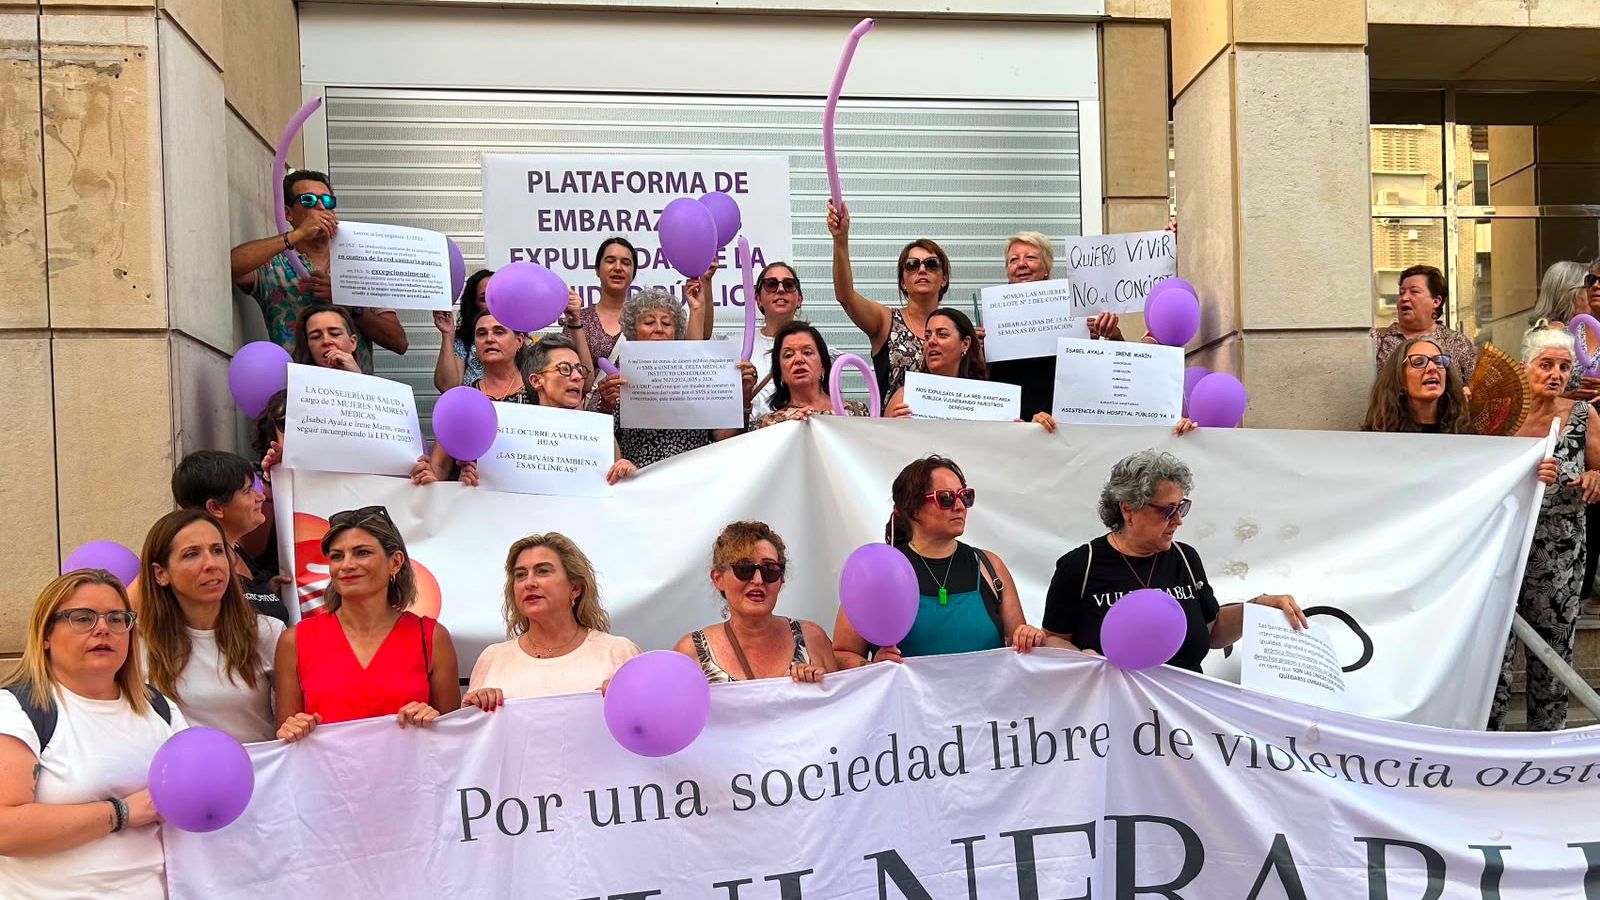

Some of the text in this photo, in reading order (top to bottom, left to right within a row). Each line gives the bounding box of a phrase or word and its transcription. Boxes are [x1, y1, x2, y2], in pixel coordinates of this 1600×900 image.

[527, 171, 749, 194] PLATAFORMA DE
[1038, 288, 1066, 296] MUJERES
[1073, 282, 1098, 307] NO
[1032, 297, 1045, 305] DEL
[997, 319, 1045, 329] EMBARAZADAS
[997, 327, 1027, 336] SEMANAS
[305, 386, 316, 395] LA
[366, 394, 376, 403] DE
[377, 396, 401, 407] SALUD
[300, 396, 319, 406] cargo
[320, 398, 329, 406] de
[375, 404, 403, 416] MADRES
[948, 404, 974, 412] DERECHOS
[1061, 407, 1095, 415] ASISTENCIA
[301, 415, 327, 427] ¿Isabel
[328, 418, 347, 429] Ayala
[354, 421, 371, 429] Irene
[296, 425, 318, 435] seguir
[320, 426, 366, 440] incumpliendo
[517, 428, 550, 438] OCURRE
[558, 432, 598, 442] VUESTRAS
[495, 451, 516, 461] ¿LAS
[592, 459, 598, 467] A
[516, 462, 537, 470] ESAS
[456, 708, 1600, 843] Por una sociedad libre de violencia obst
